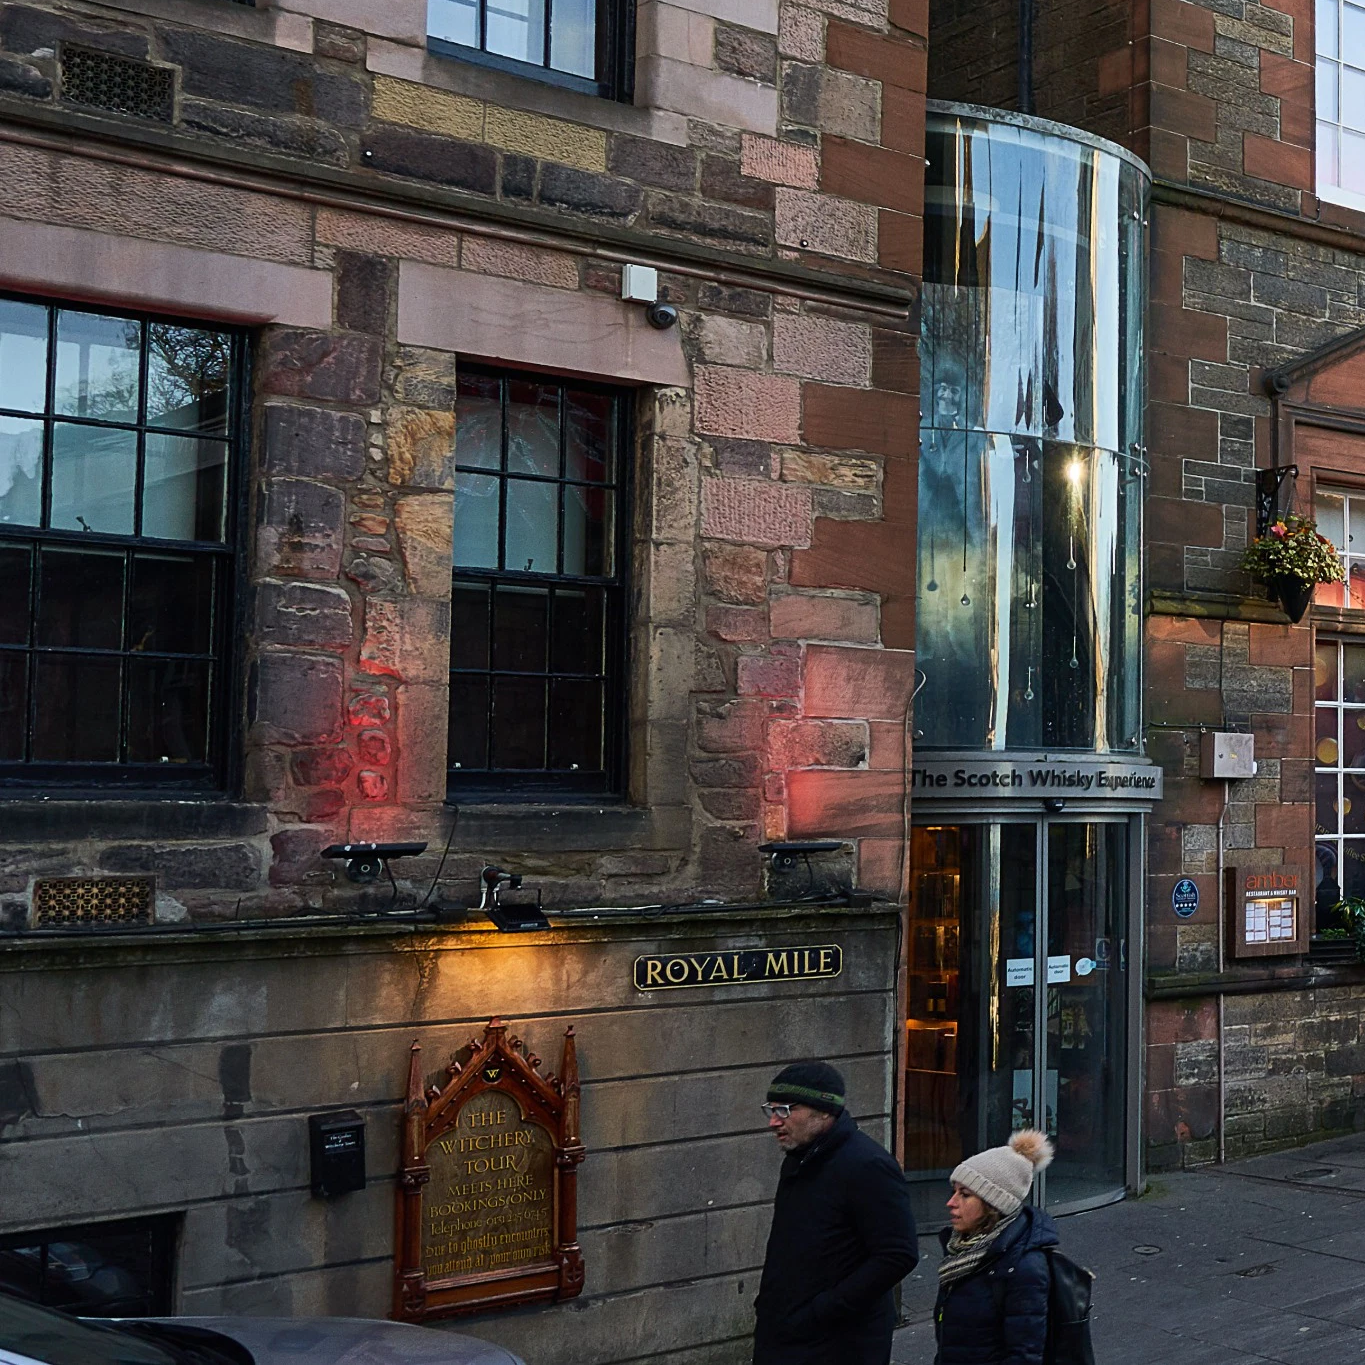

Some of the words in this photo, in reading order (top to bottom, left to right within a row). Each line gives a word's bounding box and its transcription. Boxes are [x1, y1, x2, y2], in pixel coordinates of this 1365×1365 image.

[912, 769, 948, 787] The
[953, 769, 1023, 788] Scotch
[1028, 769, 1094, 791] Whisky
[1096, 770, 1156, 791] Experience
[1245, 870, 1297, 890] amber
[646, 955, 748, 985] ROYAL
[764, 949, 834, 977] MILE
[486, 1069, 499, 1078] W
[467, 1110, 506, 1128] THE
[439, 1129, 534, 1155] WITCHERY
[464, 1155, 520, 1175] TOUR
[447, 1179, 492, 1198] MEETS
[498, 1174, 534, 1191] HERE
[430, 1196, 506, 1218] BOOKINGS
[510, 1188, 547, 1205] ONLY
[430, 1218, 483, 1237] Telephone
[425, 1245, 445, 1258] Due
[448, 1241, 458, 1253] to
[461, 1232, 498, 1255] ghostly
[427, 1262, 443, 1275] you
[444, 1254, 473, 1273] attend
[475, 1254, 485, 1267] at
[490, 1250, 511, 1266] your
[512, 1246, 532, 1261] own
[533, 1240, 552, 1257] risk
